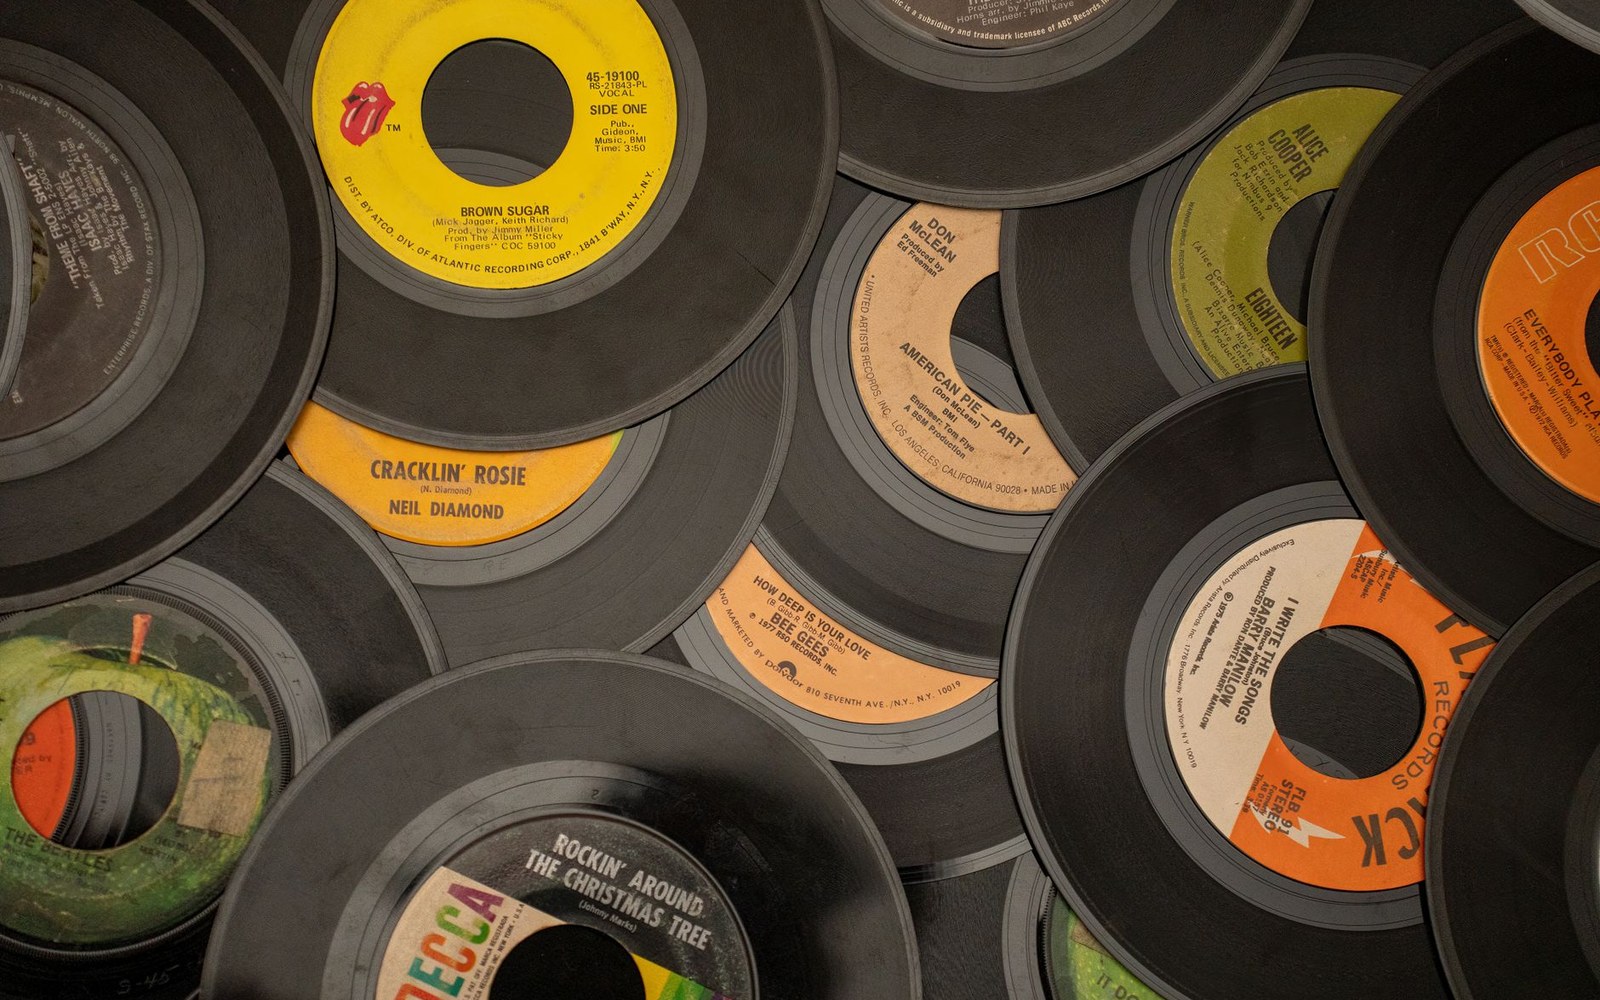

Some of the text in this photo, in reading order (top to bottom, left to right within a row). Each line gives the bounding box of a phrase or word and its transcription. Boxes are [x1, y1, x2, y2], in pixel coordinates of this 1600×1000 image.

[917, 13, 1046, 40] subsidiary and trademark licensee
[956, 12, 984, 24] Horns
[981, 11, 1027, 26] Engineer:
[1029, 4, 1049, 16] Phil
[586, 70, 640, 82] 45-19100
[589, 79, 647, 90] RS-21843-PL
[598, 89, 635, 98] VOCAL
[386, 124, 401, 132] TM
[590, 103, 648, 116] SIDE ONE
[594, 135, 646, 145] Music, BMI
[594, 144, 646, 152] Time: 3:50
[601, 128, 639, 136] Gideon,
[1291, 123, 1329, 163] ALICE
[1244, 142, 1290, 202] Bob and
[1256, 140, 1293, 192] Produced by
[1267, 129, 1312, 183] COOPER
[36, 167, 57, 200] 2-5002
[1229, 171, 1266, 222] Productions
[1233, 144, 1283, 213] Jack Richardson
[1241, 172, 1265, 204] Nimbus
[17, 158, 81, 289] "THEME FROM SHAFT"
[58, 170, 103, 252] ISAAC HAYES
[344, 176, 630, 274] DIST. BY ATCO, DIV. OF ATLANTIC RECORDING CORP., 1841 B'WAY,
[432, 215, 569, 227] (Mick Keith Richard)
[461, 205, 550, 217] BROWN SUGAR
[491, 225, 553, 235] Jimmy Miller
[927, 217, 956, 244] DON
[86, 129, 147, 375] ENTERPRISE RECORD NORTH
[444, 233, 522, 242] From The Album
[501, 241, 556, 250] COC 59100
[901, 233, 945, 273] Produced by
[908, 220, 957, 263] McLEAN
[897, 240, 937, 278] Ed Freeman
[1204, 273, 1228, 303] Dennis
[1211, 299, 1235, 331] Bizarre
[1236, 302, 1264, 336] Michael
[1244, 287, 1298, 350] EIGHTEEN
[859, 280, 1058, 495] UNITED ARTISTS RECORDS, LOS CALIFORNIA 90028 MADE
[1523, 309, 1583, 387] EVERYBODY
[1578, 391, 1600, 426] PLA
[899, 342, 961, 396] AMERICAN
[990, 419, 1024, 448] PART
[932, 386, 981, 429] (Don McLean)
[942, 407, 958, 423] BMI
[909, 394, 975, 453] Engineer: Tom Flye
[911, 410, 966, 460] BSM Production
[370, 459, 527, 486] CRACKLIN' ROSIE
[434, 485, 472, 496] Diamond)
[389, 499, 504, 520] NEIL DIAMOND
[753, 575, 872, 661] HOW DEEP IS YOUR LOVE
[770, 612, 829, 658] BEE GEES
[777, 604, 846, 655] Gibb-R. Gibb-M. Gibb)
[1207, 601, 1228, 637] 1975 Arista
[716, 587, 961, 706] AND MARKETED BY 810 SEVENTH 10019
[758, 618, 837, 675] 1977 RSO RECORDS, INC.
[1181, 538, 1295, 769] Exclusively Distributed Arista 1776 10019
[1199, 566, 1276, 730] PRODUCED BY RON DANTE BARRY MANILOW
[1219, 596, 1275, 708] BARRY MANILOW
[1234, 606, 1296, 725] WRITE THE SONGS
[1241, 626, 1272, 686] (Bruce Johnston)
[1390, 680, 1451, 790] RECORDS
[1258, 784, 1278, 816] Formerly
[1264, 779, 1294, 831] STEREO
[1276, 786, 1307, 835] FLB. 91
[6, 826, 37, 848] THE
[552, 833, 704, 916] ROCKIN' AROUND
[525, 848, 712, 950] THE CHRISTMAS TREE
[578, 899, 637, 933] (Johnny Marks)
[1096, 972, 1112, 990] IT
